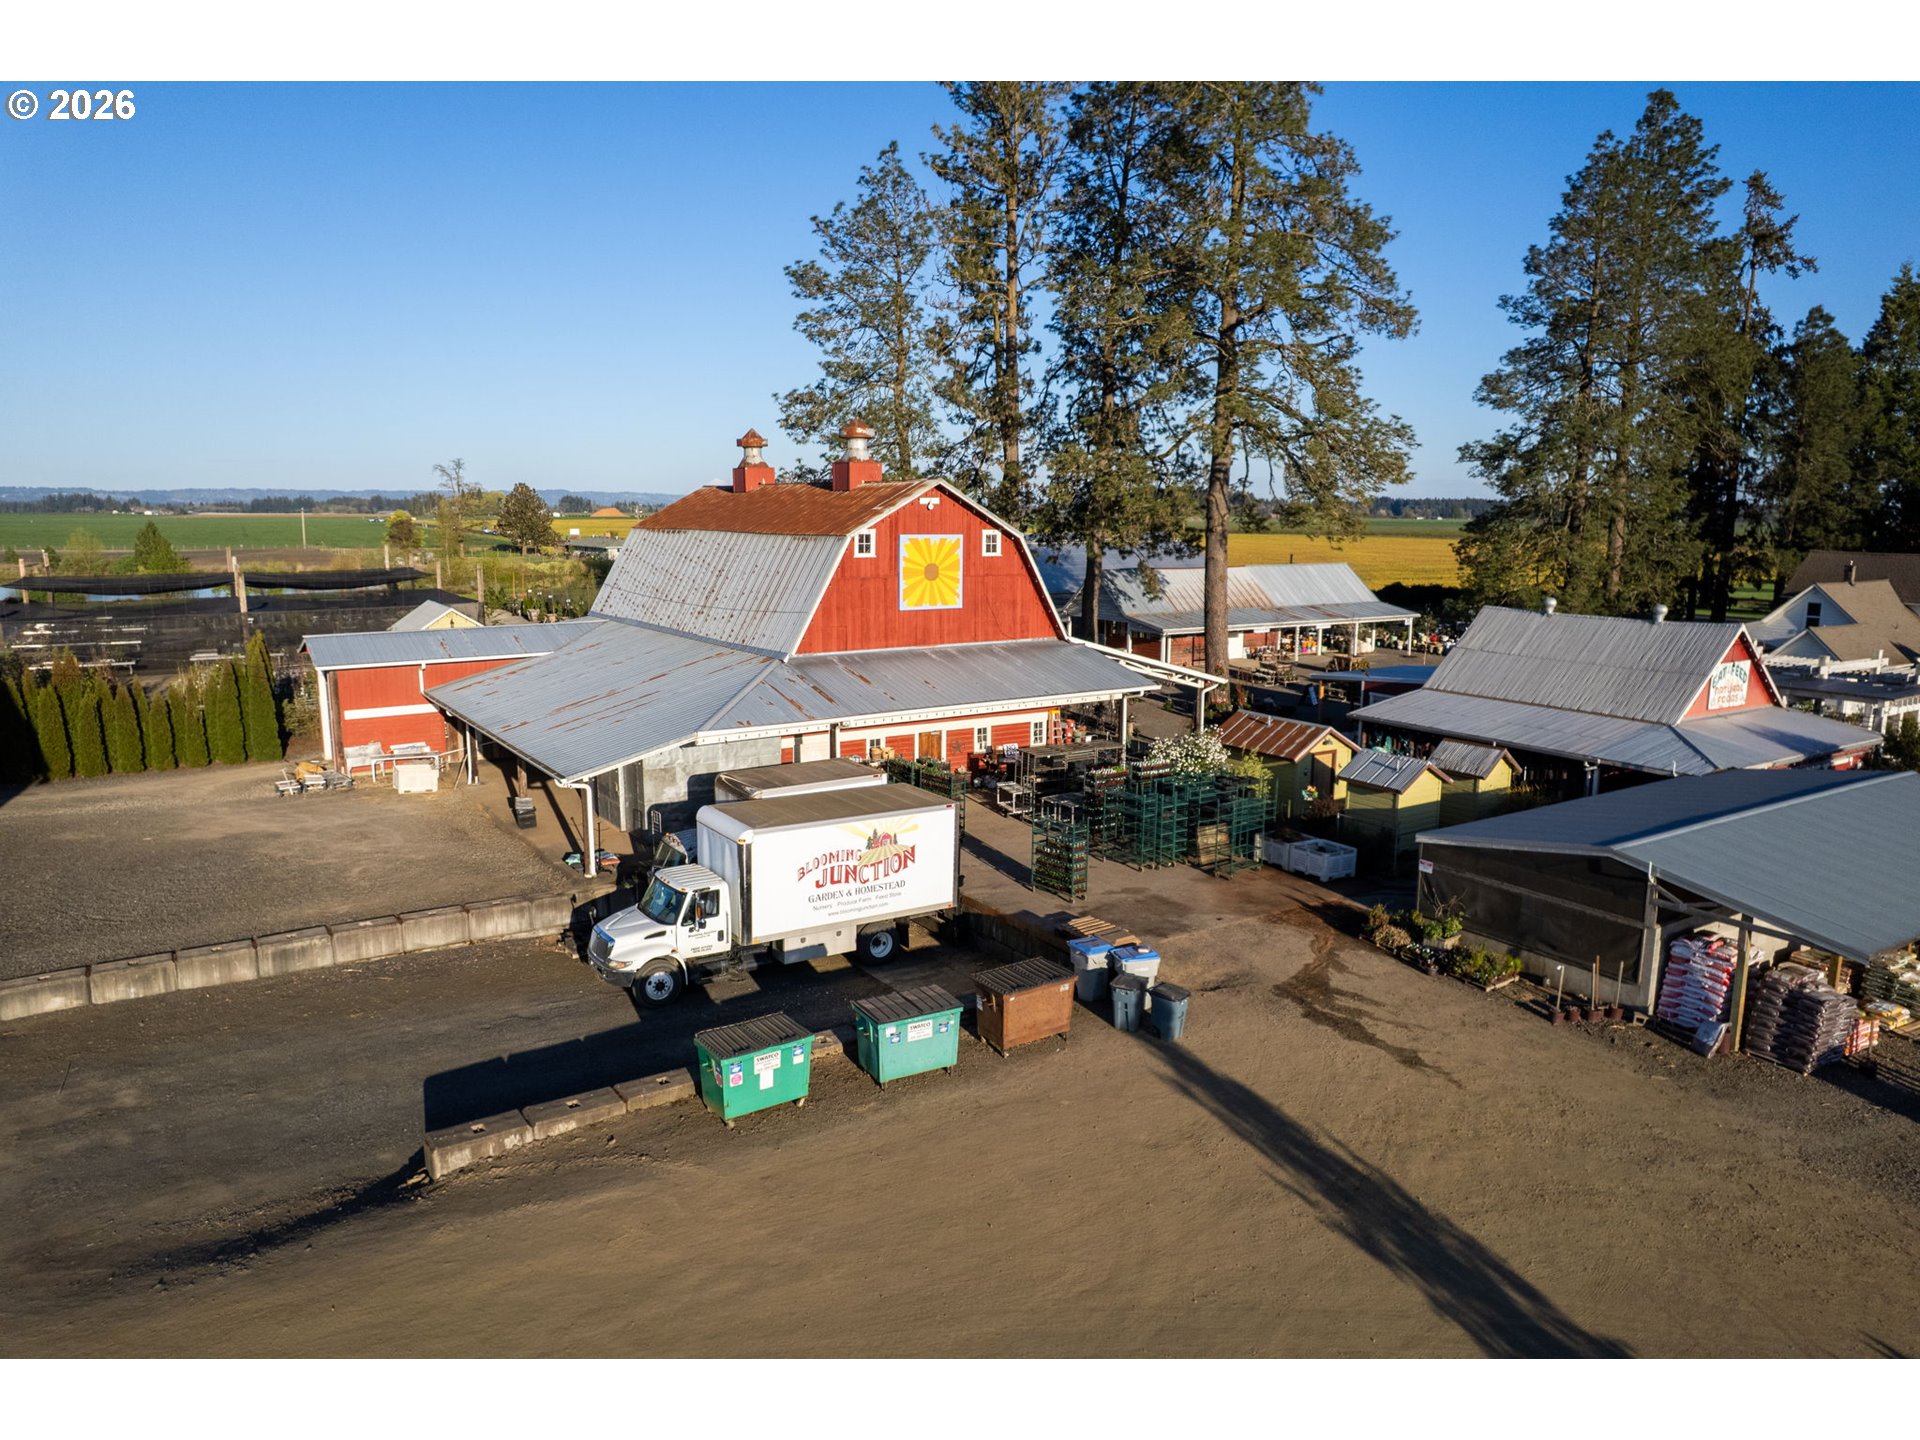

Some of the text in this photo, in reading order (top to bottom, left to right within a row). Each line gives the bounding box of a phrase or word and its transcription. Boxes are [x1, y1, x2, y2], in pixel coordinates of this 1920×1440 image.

[1712, 666, 1728, 689] EAT
[1731, 663, 1748, 684] FEED
[797, 848, 862, 882] BLOOMING
[815, 844, 916, 889] JUNCTION
[808, 880, 906, 904] GARDEN & HOMESTEAD
[812, 903, 833, 912] Nursery
[837, 898, 858, 906] Produce
